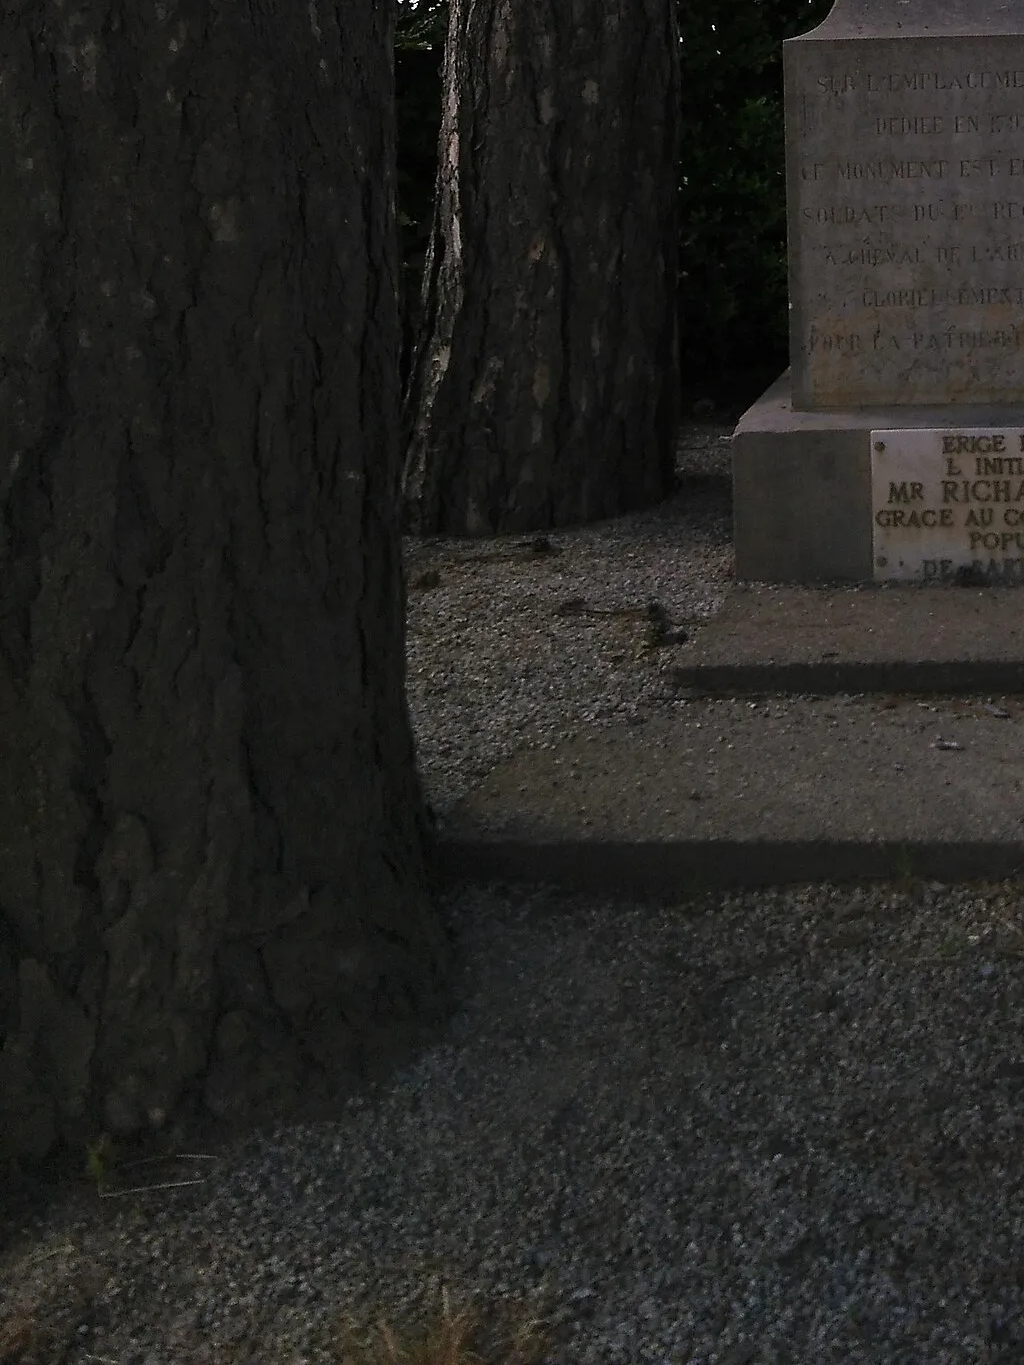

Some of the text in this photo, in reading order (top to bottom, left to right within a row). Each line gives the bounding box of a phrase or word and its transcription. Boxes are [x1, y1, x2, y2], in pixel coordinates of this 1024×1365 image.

[817, 73, 856, 94] SUR
[954, 115, 979, 135] EN
[837, 160, 950, 180] MONUMENT
[959, 159, 1000, 179] EST
[803, 205, 902, 225] SOLDATS
[914, 203, 942, 222] DU
[848, 247, 924, 266] CHEVAL
[887, 482, 925, 504] MR
[874, 509, 954, 528] GRACE
[964, 508, 994, 527] AU
[922, 559, 953, 582] DE
